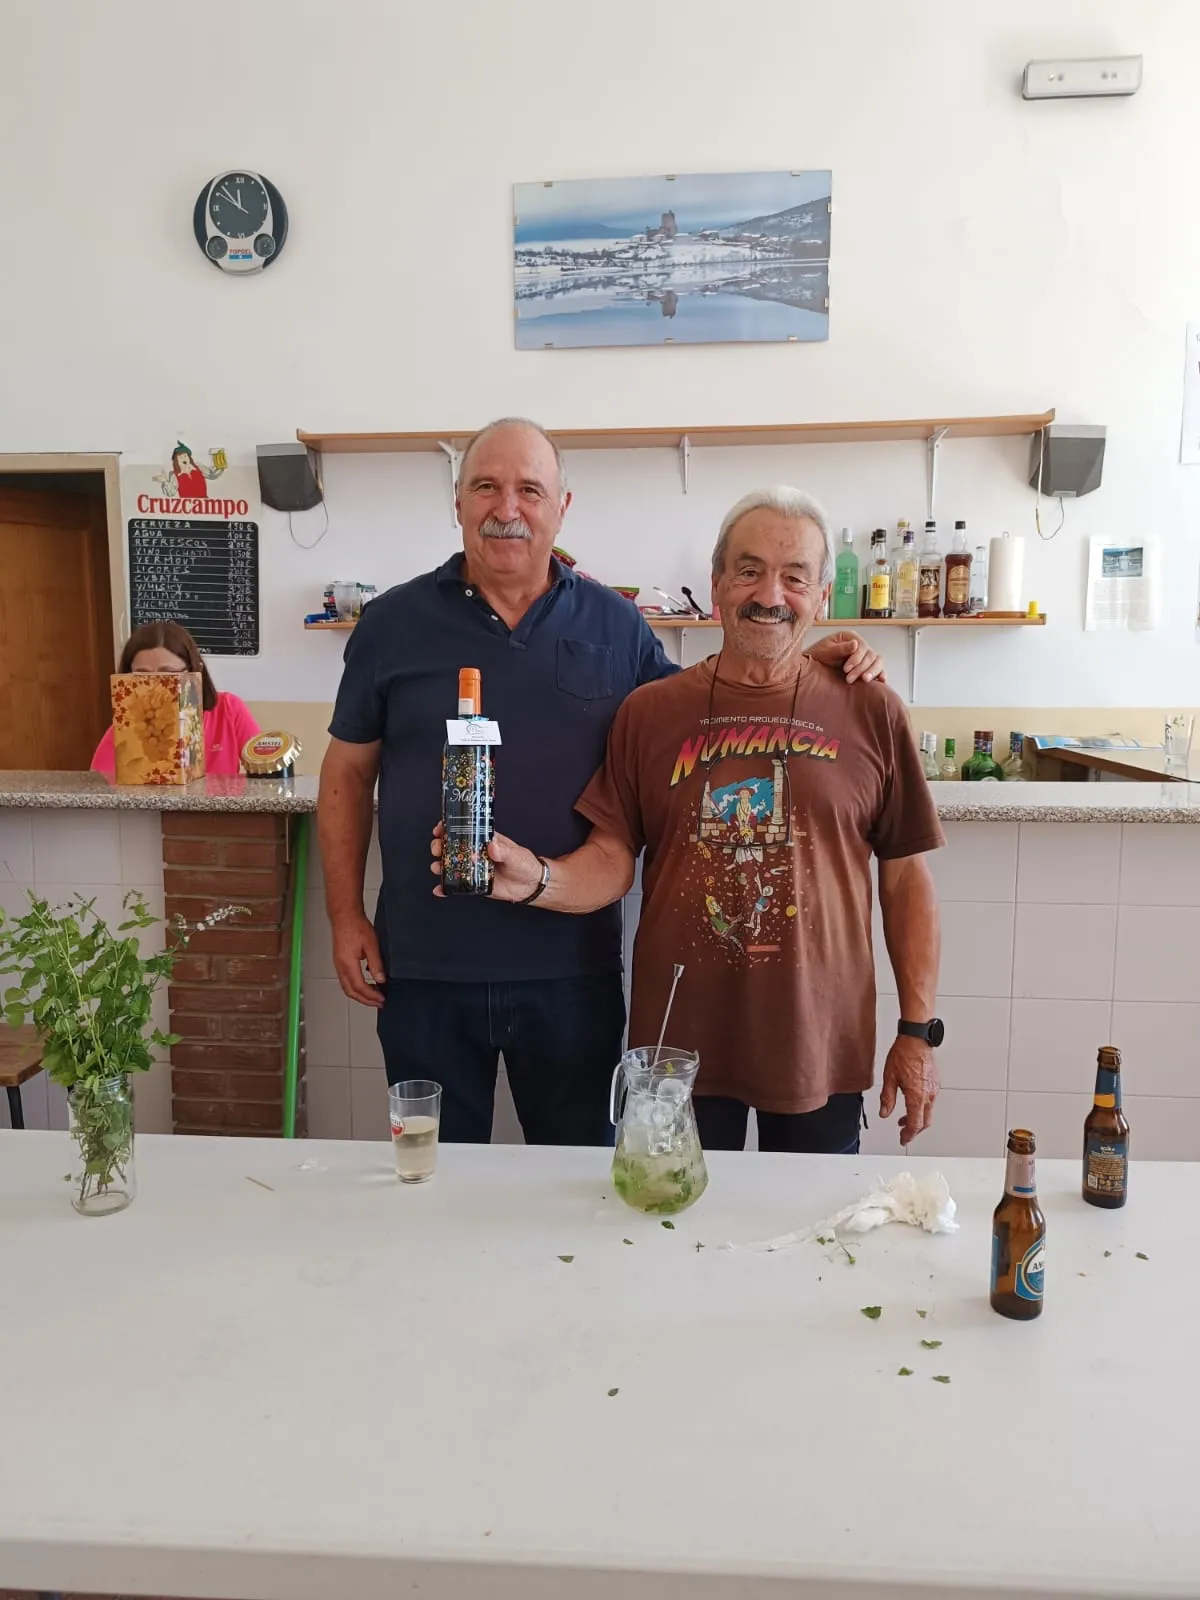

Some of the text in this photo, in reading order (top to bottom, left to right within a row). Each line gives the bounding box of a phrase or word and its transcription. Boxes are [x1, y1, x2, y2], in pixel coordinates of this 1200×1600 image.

[137, 494, 249, 519] Cruzcampo
[134, 520, 191, 528] CERVEZA
[134, 530, 163, 538] AGUA
[135, 538, 208, 548] REFRESCOS
[135, 547, 160, 556] VINO
[136, 564, 190, 574] LICORES
[670, 725, 841, 787] NUMANCIA
